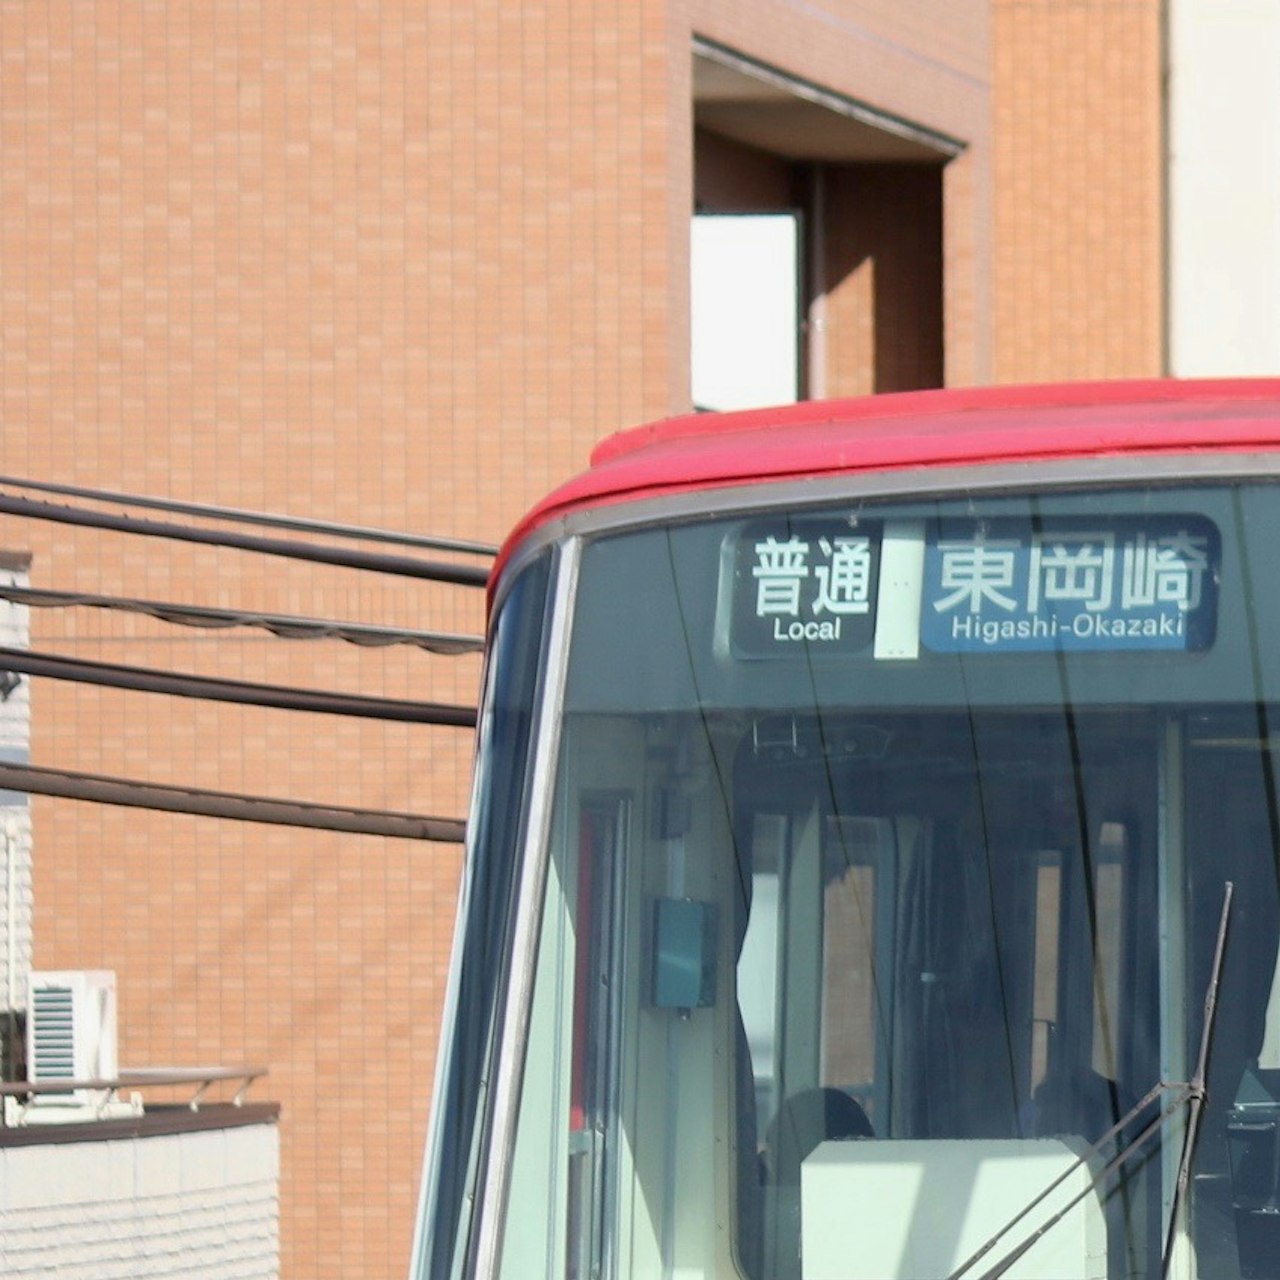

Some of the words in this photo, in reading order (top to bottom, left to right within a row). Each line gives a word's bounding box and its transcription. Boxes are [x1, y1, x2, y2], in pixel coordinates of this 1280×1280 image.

[752, 534, 871, 617] 普通
[933, 530, 1209, 613] 東岡崎
[773, 616, 841, 641] Local
[951, 612, 1185, 644] Higashi-Okazaki
